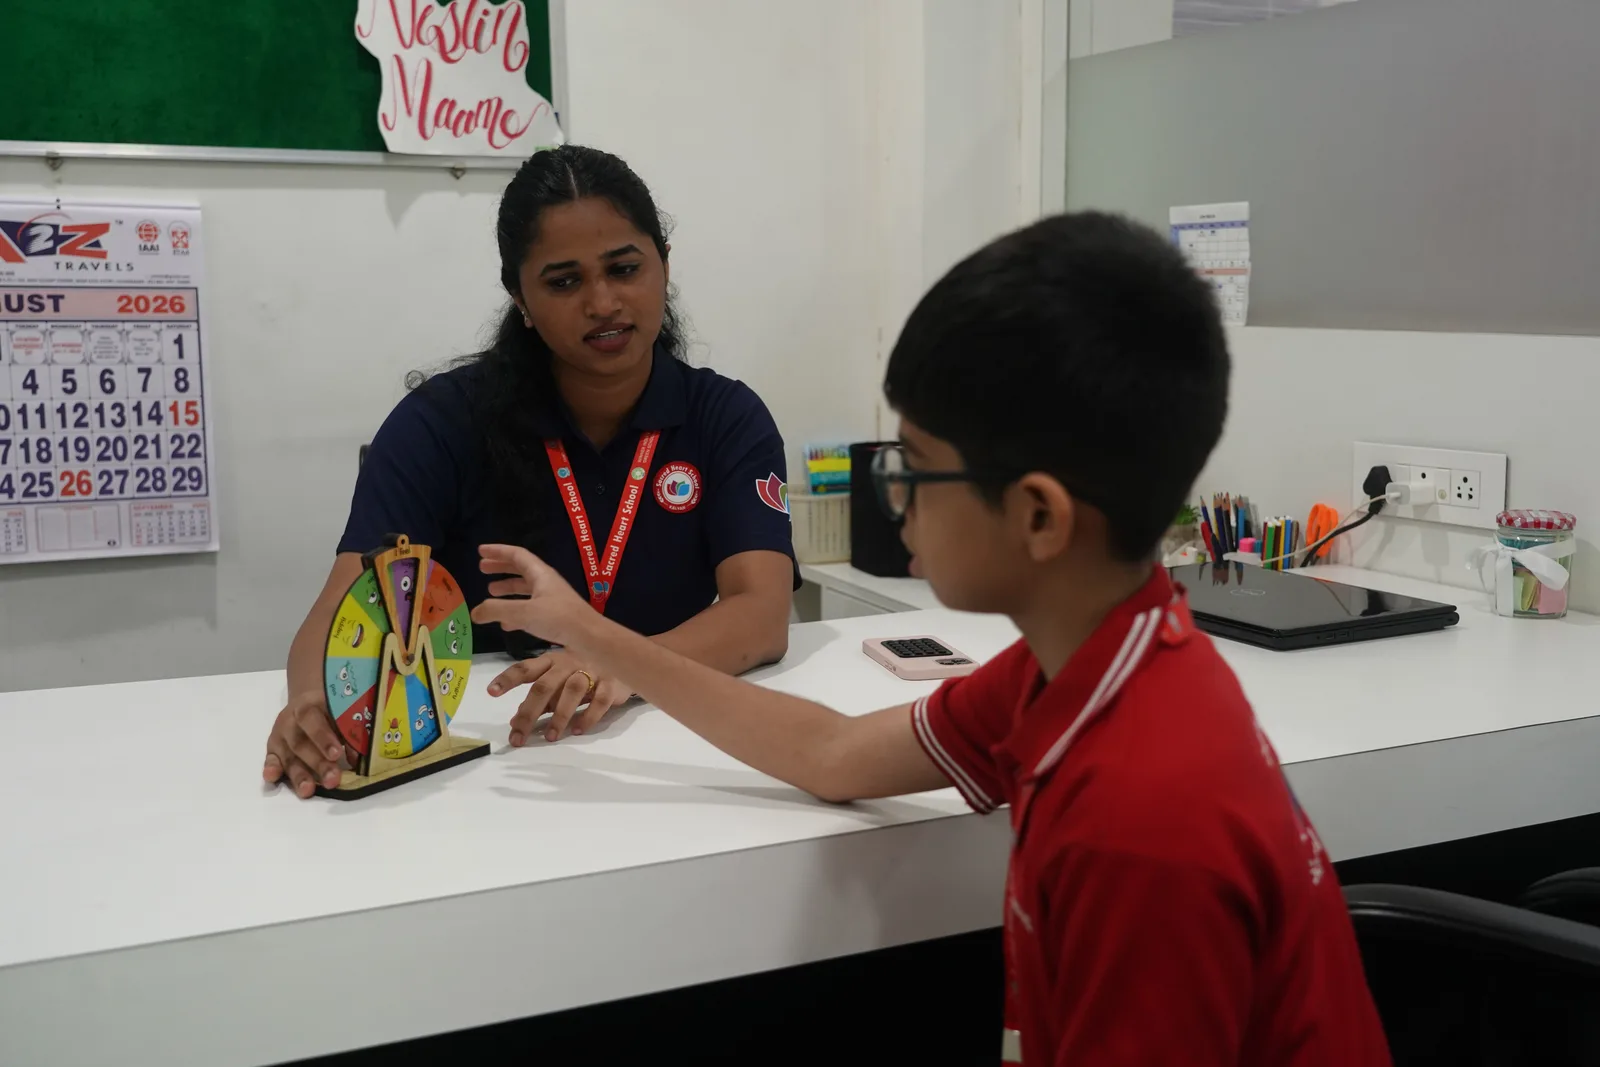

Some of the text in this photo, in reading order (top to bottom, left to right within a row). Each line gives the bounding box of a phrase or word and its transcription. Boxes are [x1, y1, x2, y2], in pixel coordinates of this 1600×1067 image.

[54, 261, 134, 271] TRAVELS
[0, 294, 185, 314] UST 2026
[173, 333, 184, 360] 1
[22, 366, 190, 395] 4 5 6 7 8
[17, 403, 46, 429] 11
[56, 402, 89, 429] 12
[95, 402, 126, 428] 13
[132, 400, 163, 426] 14
[169, 400, 200, 426] 15
[19, 437, 52, 464] 18
[58, 436, 90, 463] 19
[96, 436, 128, 462] 20
[133, 434, 162, 459] 21
[170, 433, 202, 459] 22
[21, 472, 54, 498] 25
[60, 470, 93, 497] 26
[98, 469, 129, 495] 27
[135, 467, 167, 493] 28
[172, 466, 203, 492] 29
[656, 464, 700, 489] Sacred Heart School
[563, 482, 599, 577] Sacred Heart School
[602, 484, 639, 576] Sacred Heart School
